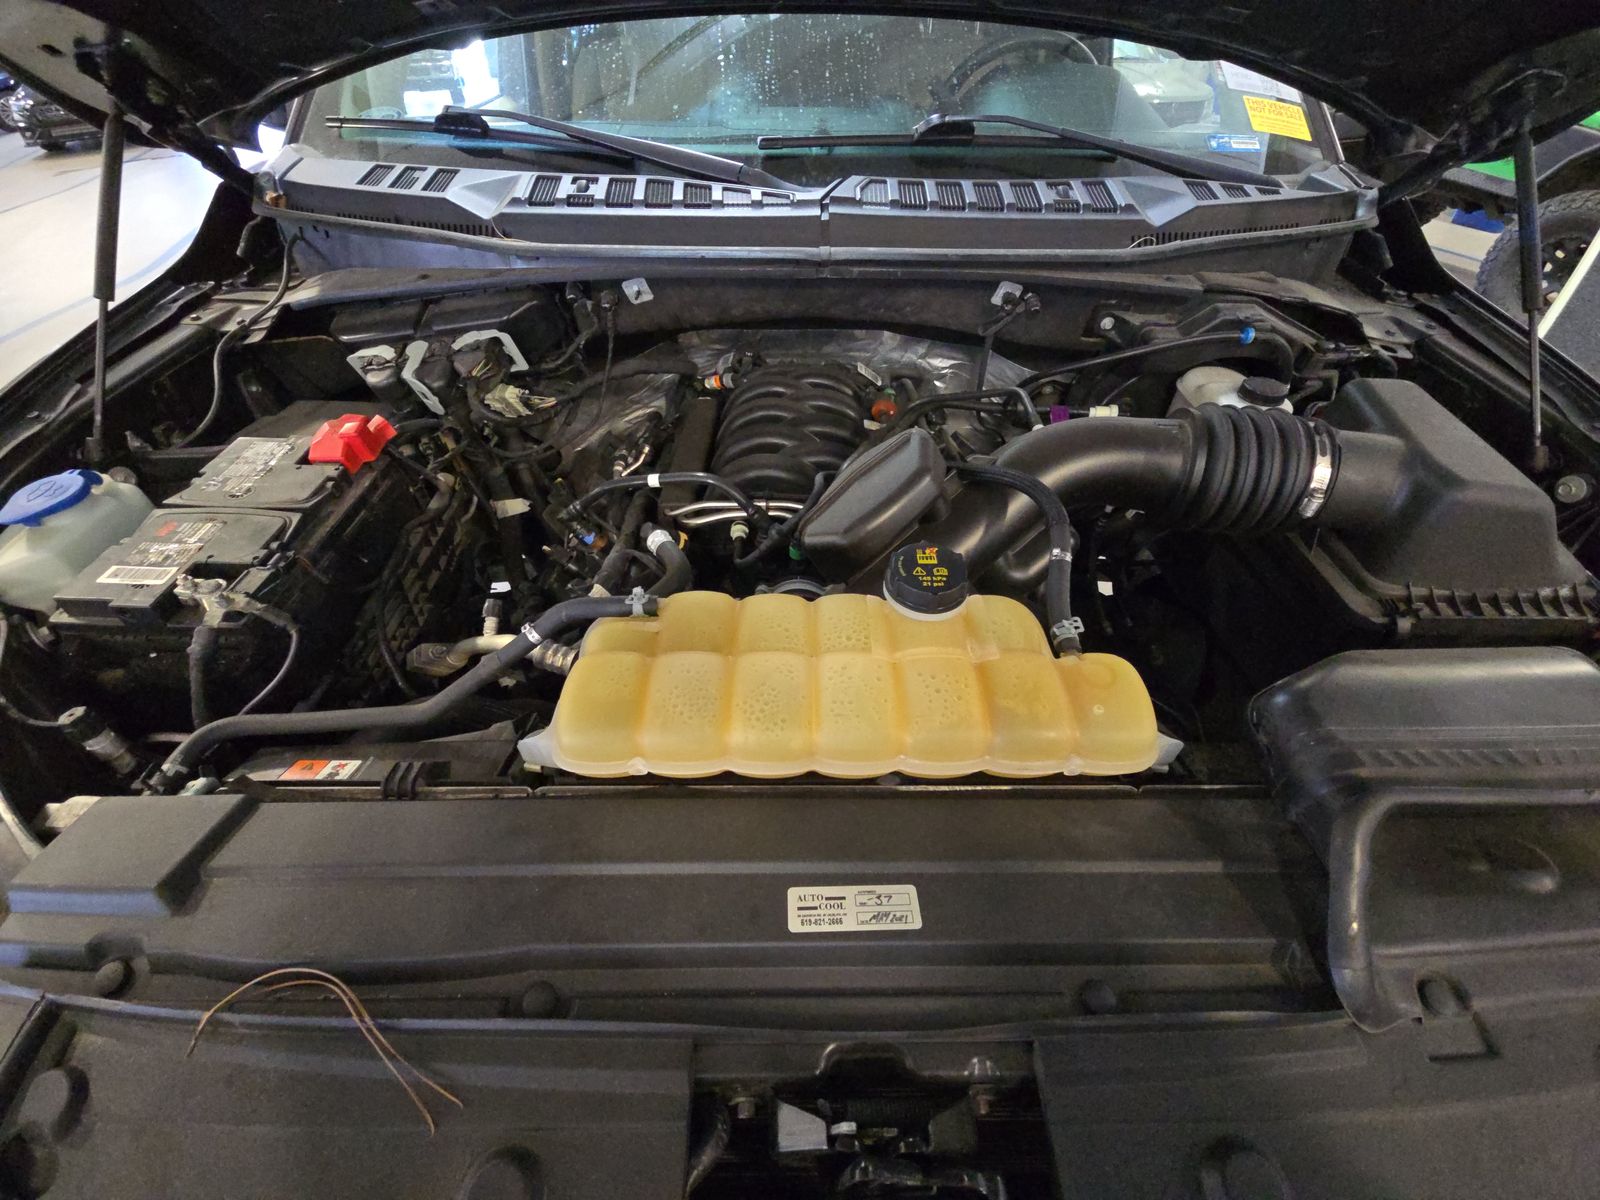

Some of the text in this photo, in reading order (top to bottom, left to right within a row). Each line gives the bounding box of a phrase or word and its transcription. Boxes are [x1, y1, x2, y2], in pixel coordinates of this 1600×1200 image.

[1245, 97, 1301, 114] THIS VEHICLE
[1248, 105, 1266, 113] NOT
[1267, 108, 1284, 116] FOR
[1284, 111, 1303, 121] SALE
[797, 894, 824, 903] AUTO
[818, 902, 847, 911] COOL
